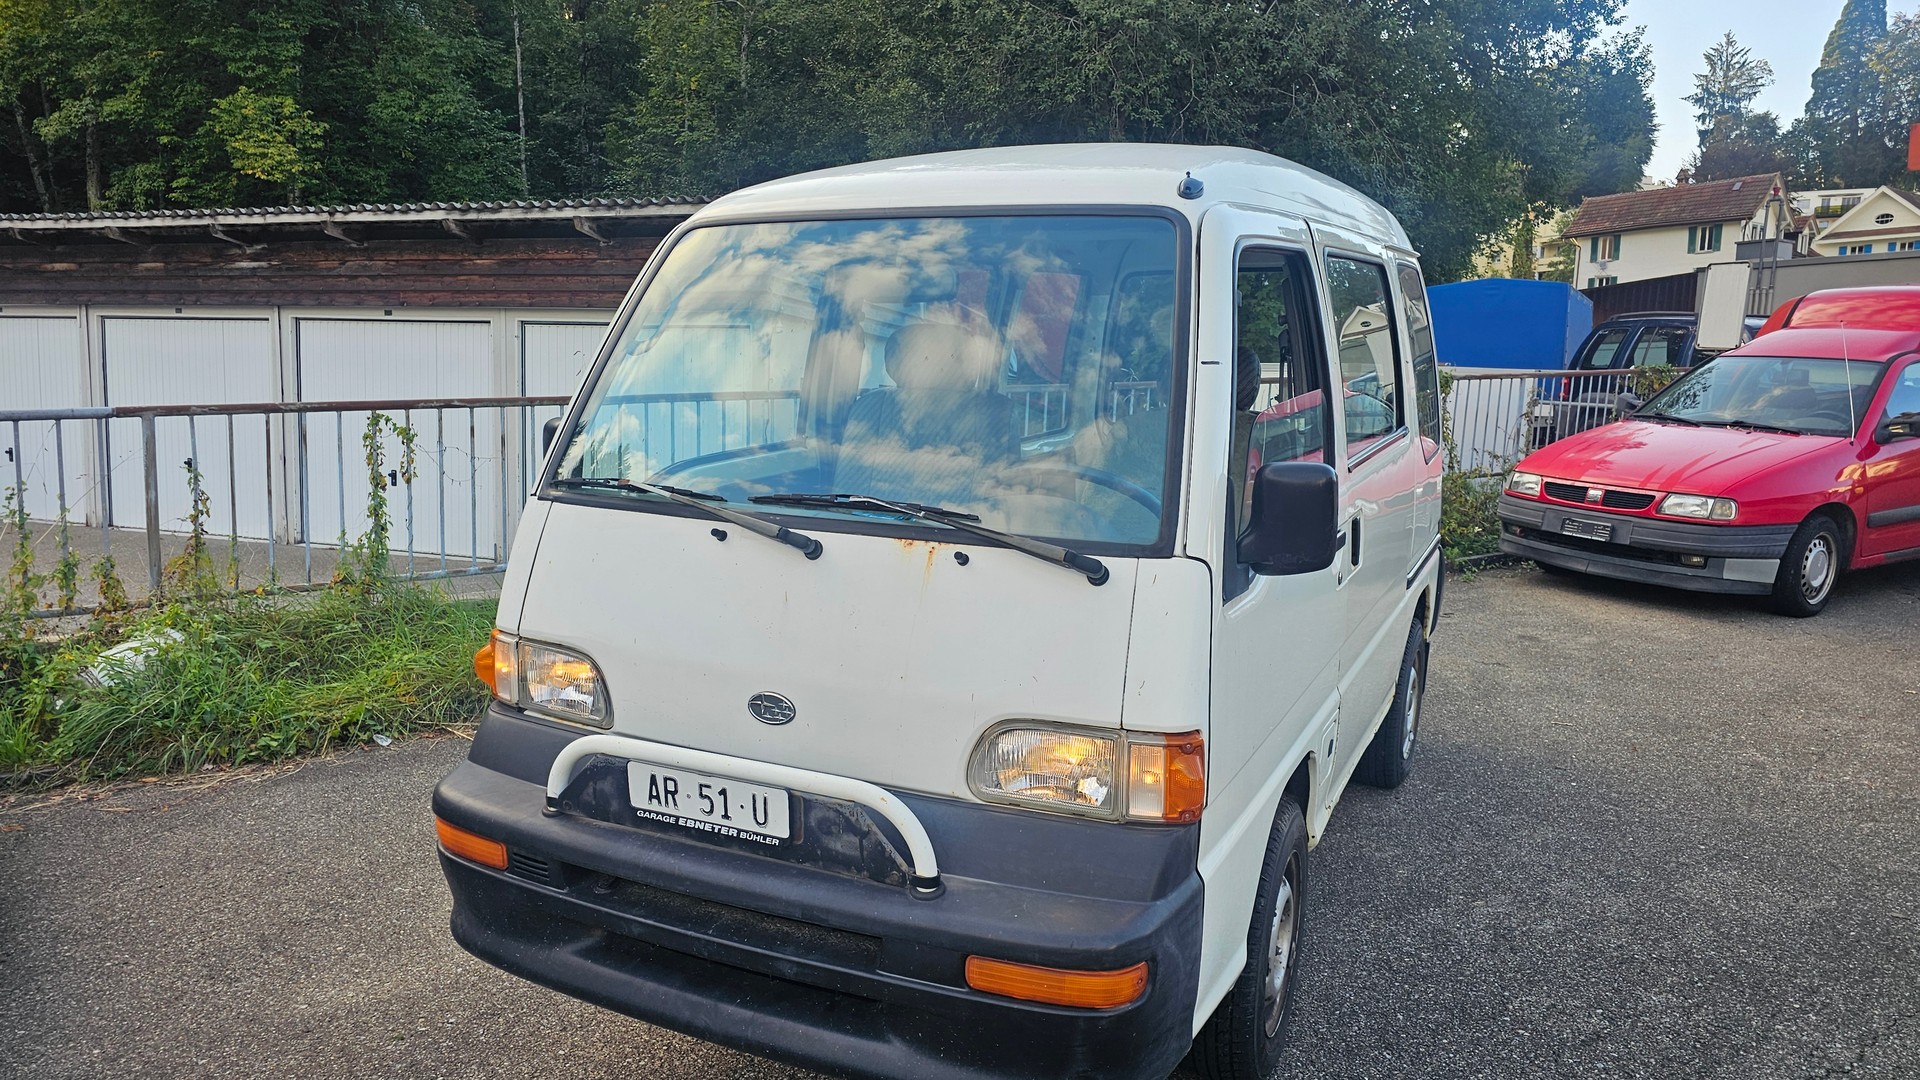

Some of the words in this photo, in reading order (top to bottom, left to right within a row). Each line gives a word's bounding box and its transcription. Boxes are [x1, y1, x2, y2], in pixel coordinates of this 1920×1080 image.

[636, 810, 677, 824] GARAGE
[678, 817, 739, 837] EBNETER
[739, 831, 780, 846] BÜHLER
